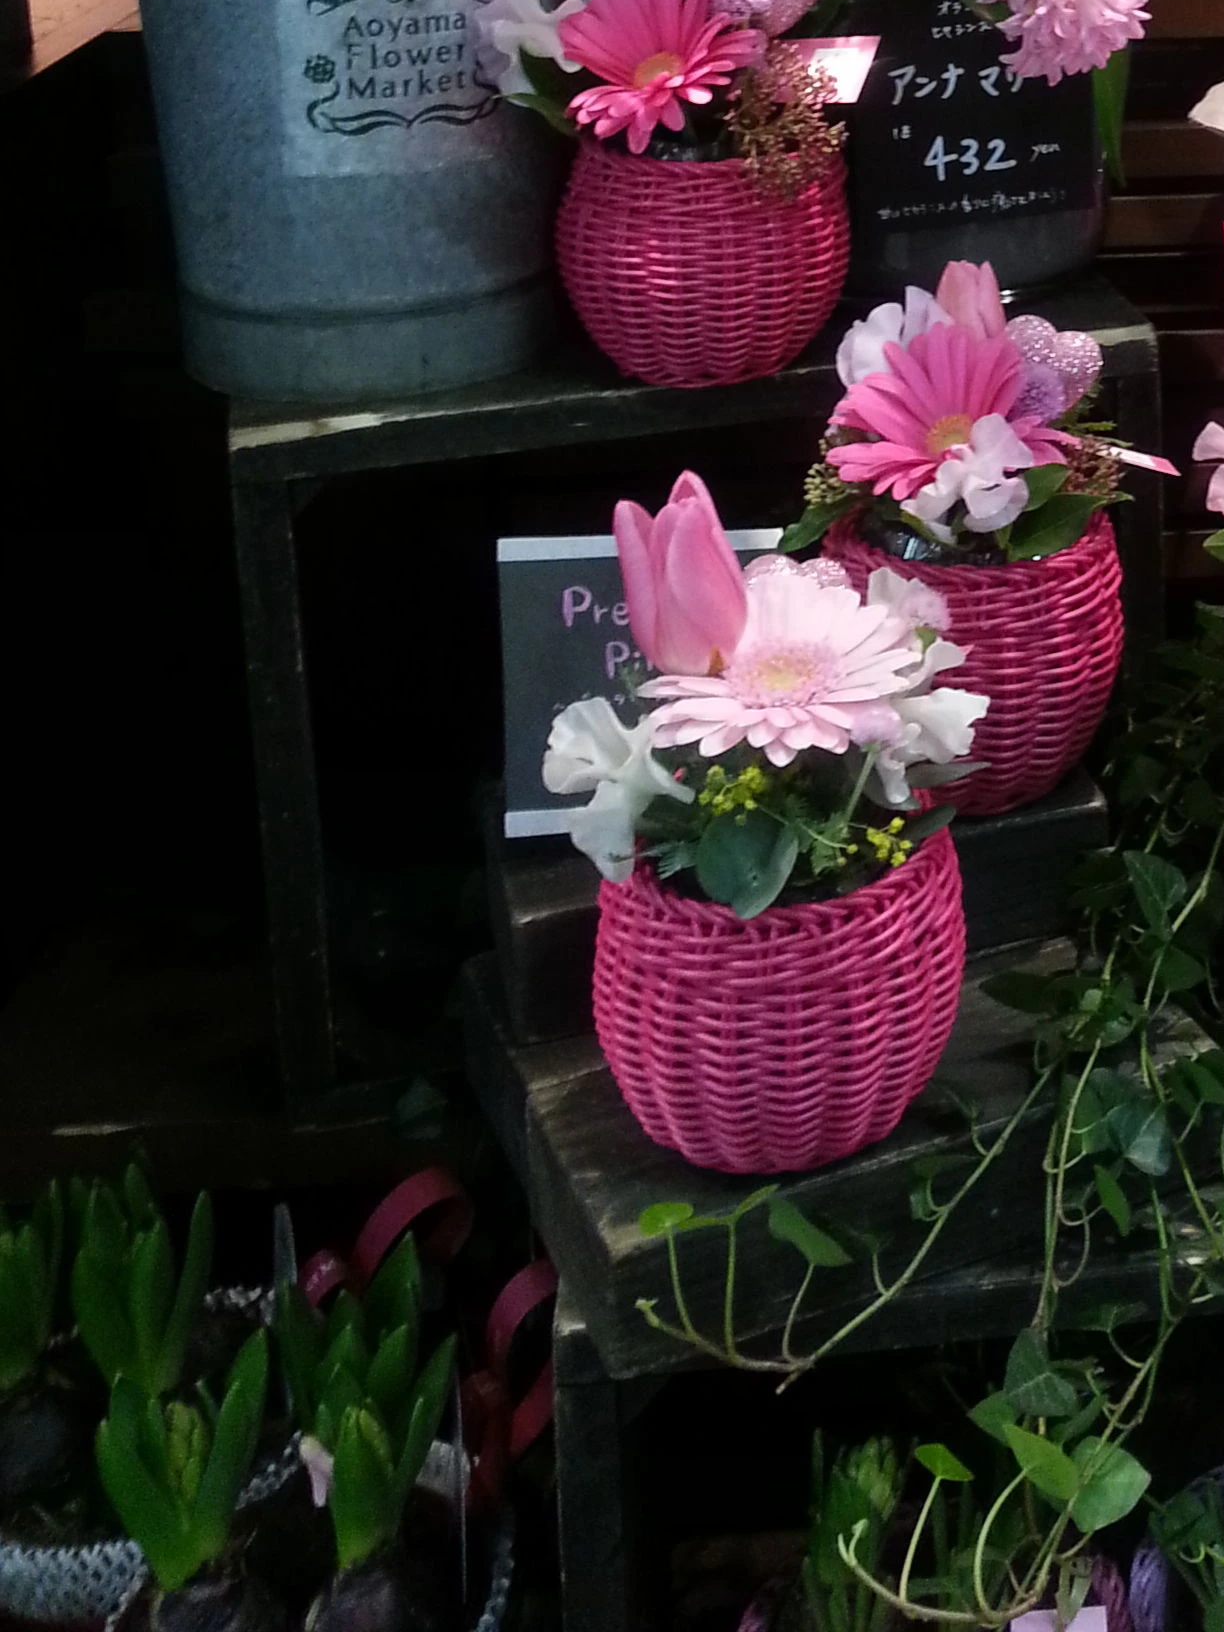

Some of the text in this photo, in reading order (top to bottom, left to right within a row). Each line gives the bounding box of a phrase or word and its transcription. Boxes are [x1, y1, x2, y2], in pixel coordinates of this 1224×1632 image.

[344, 12, 467, 43] Aoyama
[346, 42, 466, 70] Flower
[346, 70, 467, 100] Market
[888, 62, 966, 105] アンナ
[924, 134, 1018, 182] 432
[1029, 142, 1061, 162] yen
